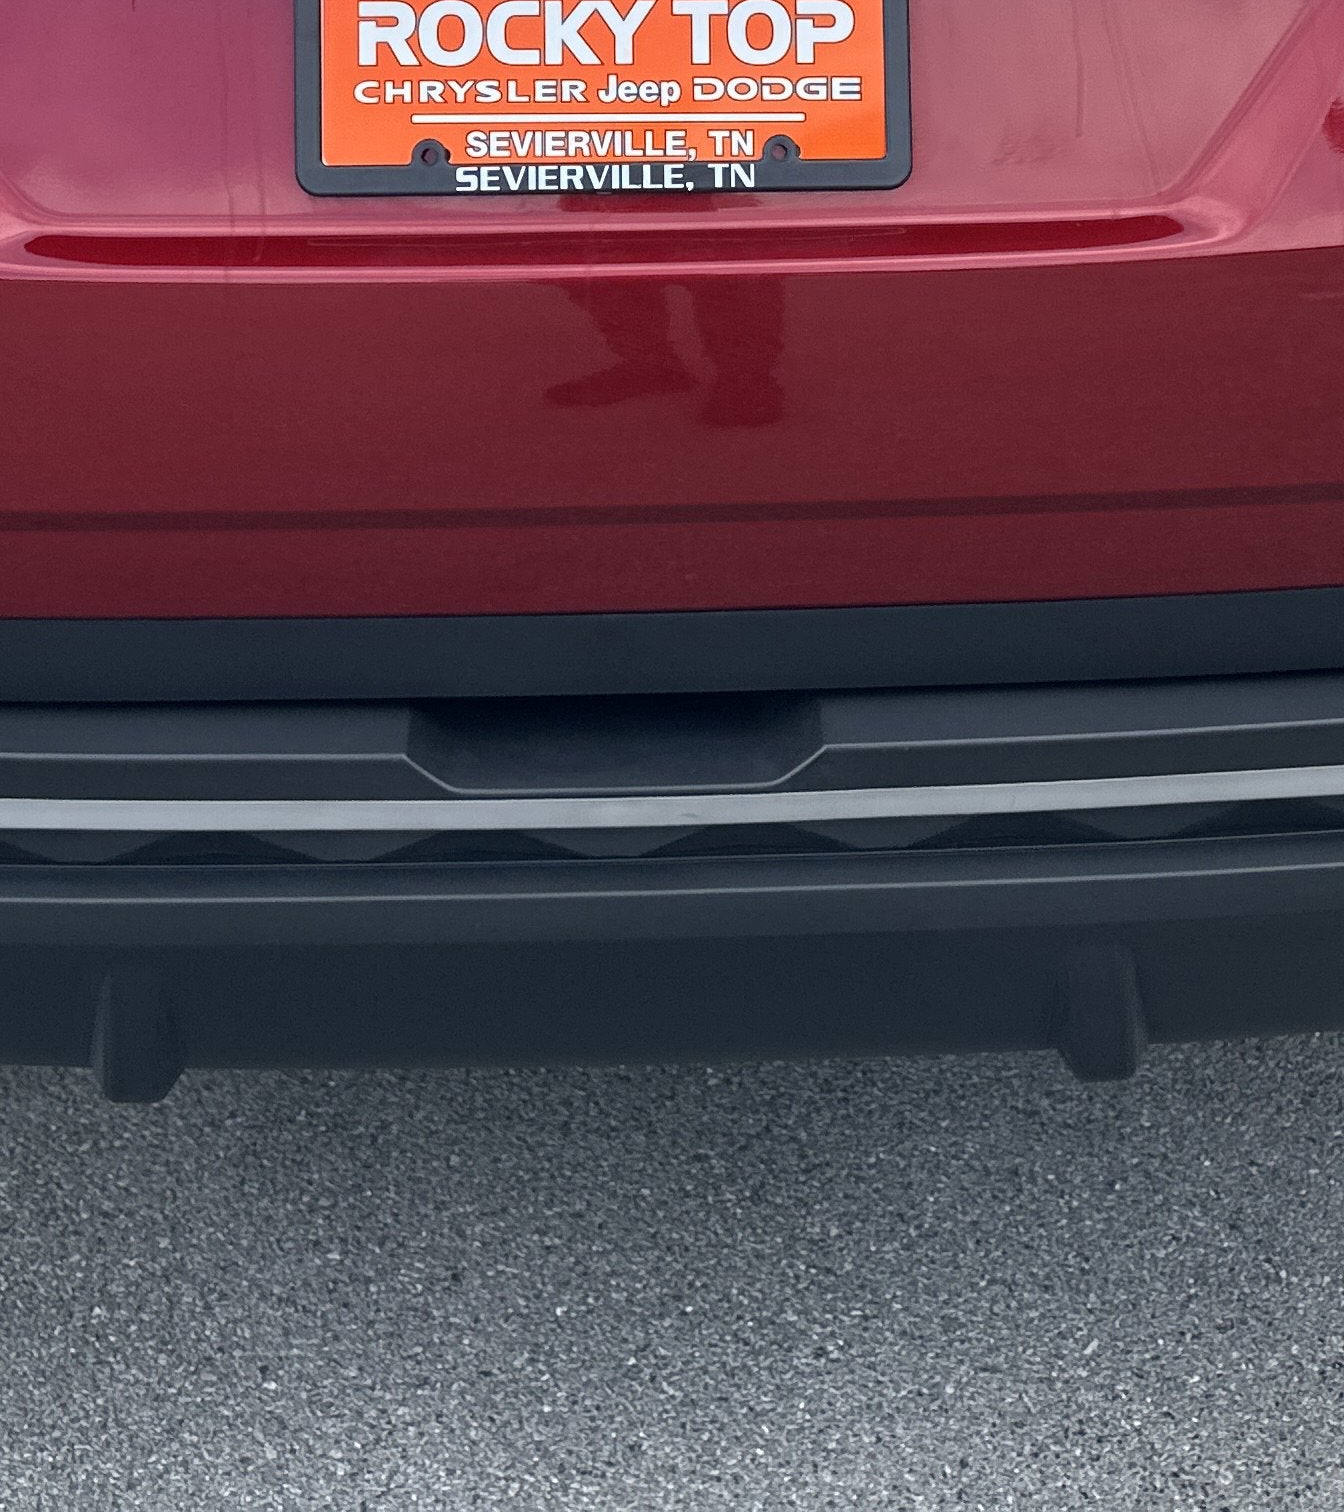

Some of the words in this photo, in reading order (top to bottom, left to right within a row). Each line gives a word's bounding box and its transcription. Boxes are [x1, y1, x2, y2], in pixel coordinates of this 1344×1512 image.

[353, 78, 588, 104] CHRYSLER
[596, 73, 681, 107] Jeep
[693, 75, 863, 102] DODGE
[465, 130, 697, 161] SEVIERVILLE,
[707, 129, 755, 157] TN
[455, 163, 694, 192] SEVIERVILLE,
[708, 162, 755, 189] TN
